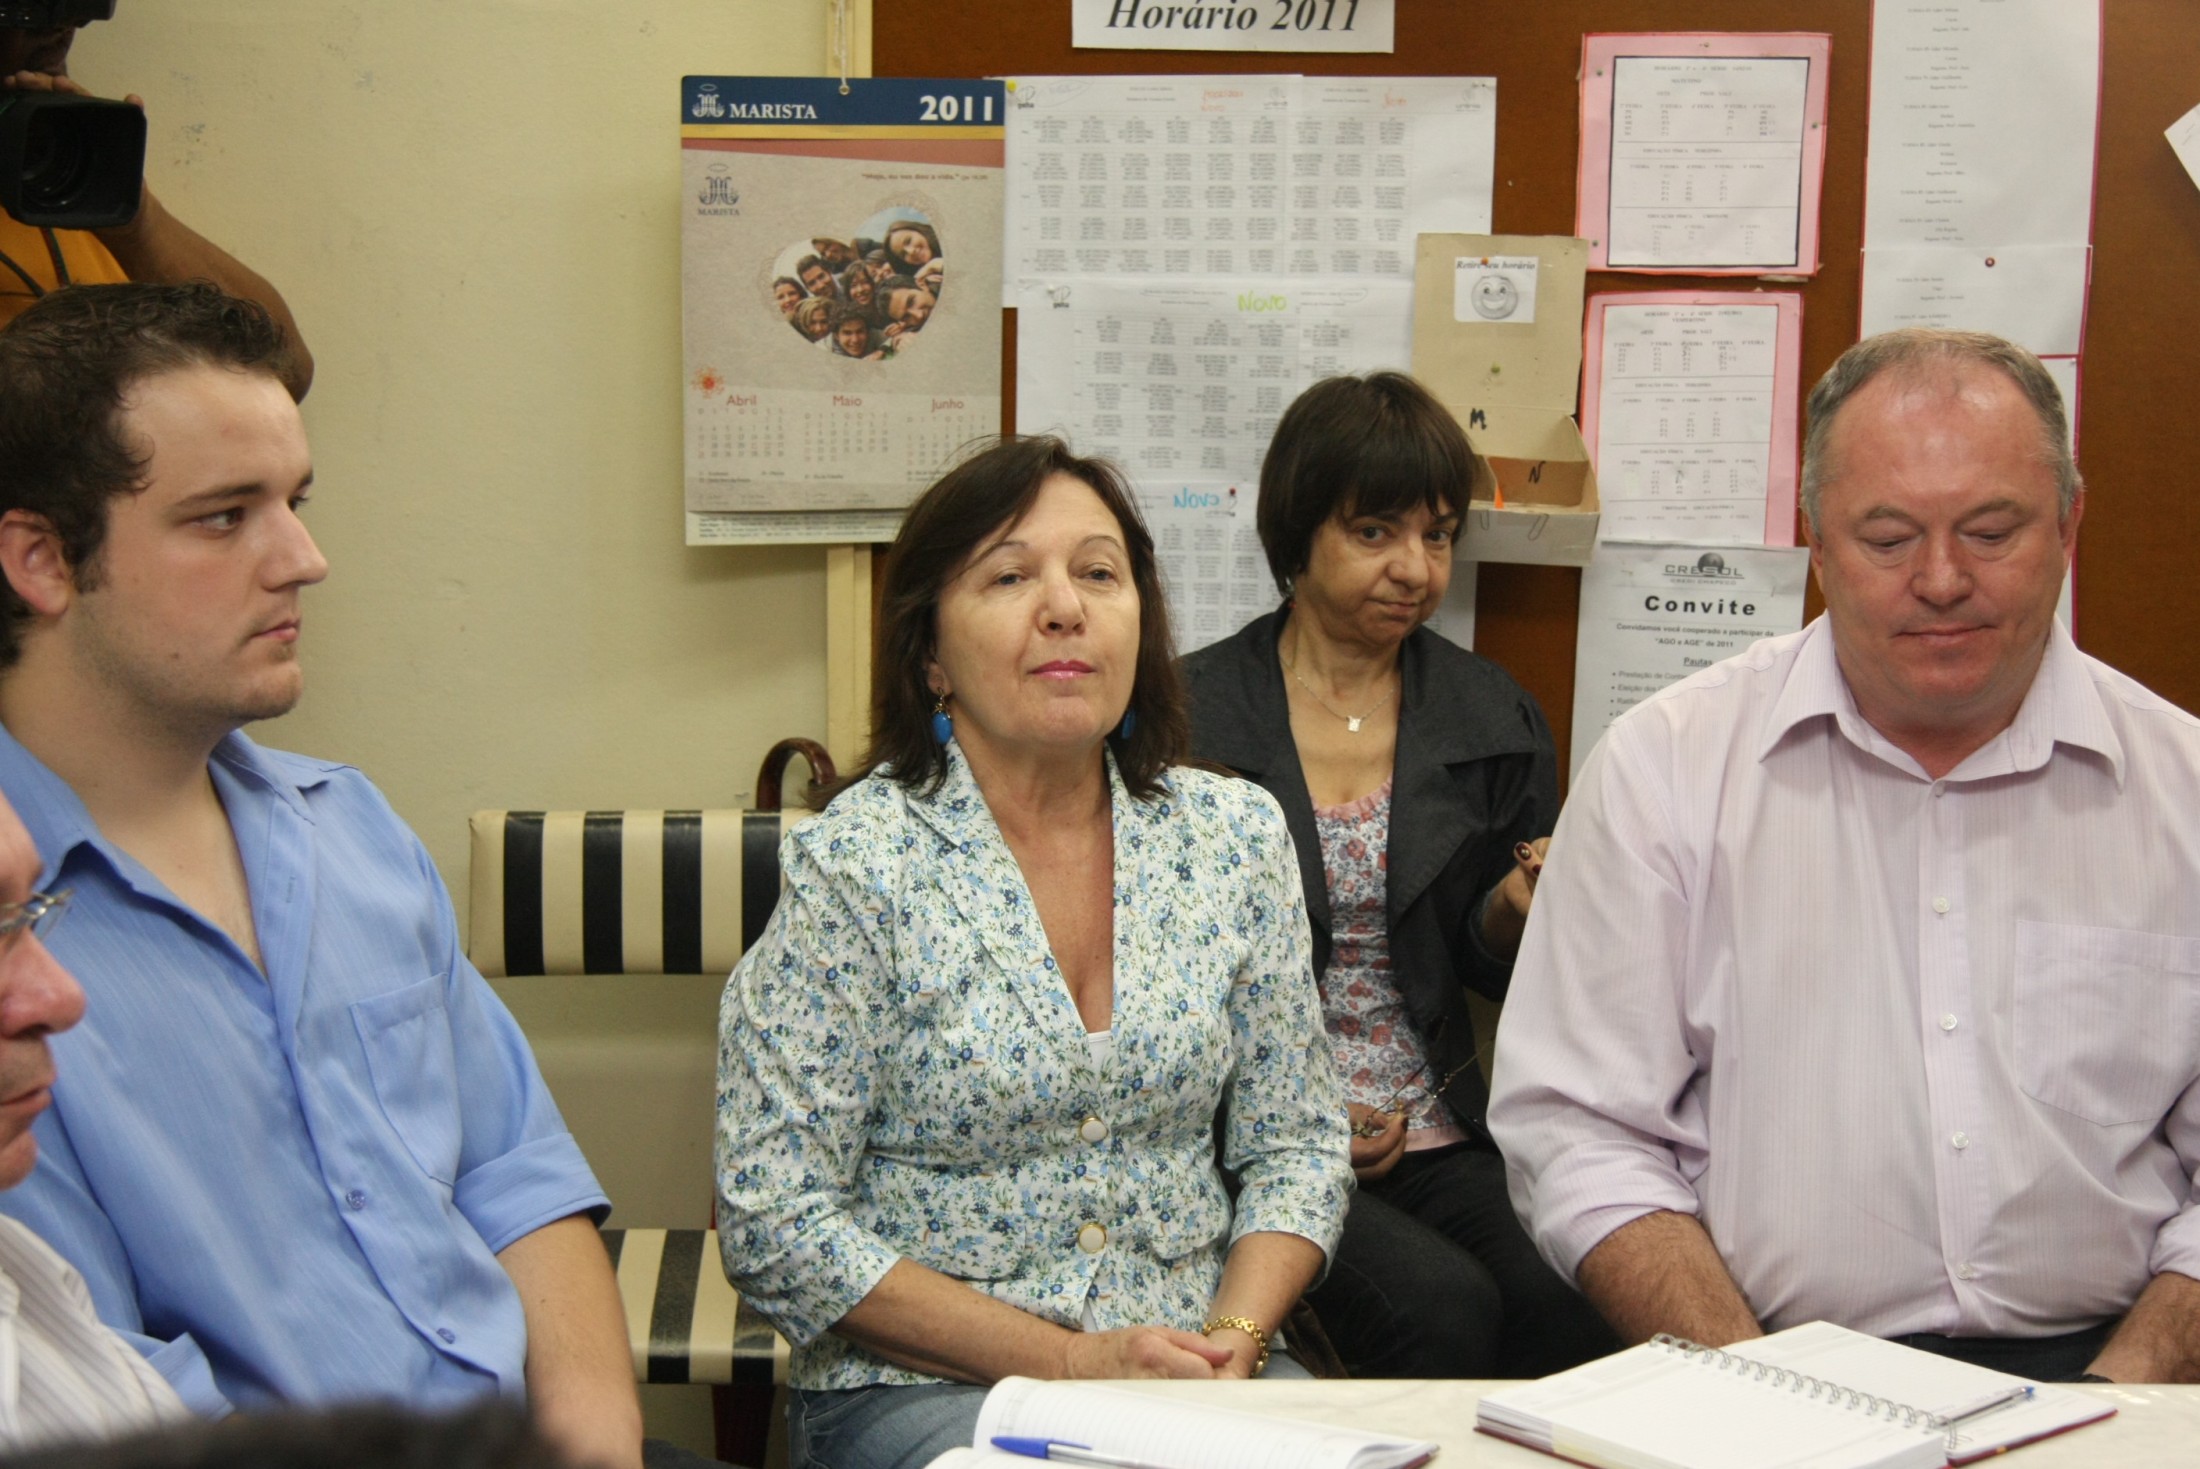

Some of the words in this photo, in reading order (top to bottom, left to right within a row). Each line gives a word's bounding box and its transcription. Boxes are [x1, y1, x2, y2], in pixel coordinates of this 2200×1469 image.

[1105, 0, 1258, 30] Horário
[1270, 0, 1361, 31] 2011
[729, 103, 818, 119] MARISTA
[919, 95, 993, 122] 2011
[726, 395, 757, 406] Abril
[833, 395, 862, 407] Maio
[931, 398, 964, 412] Junho
[1664, 564, 1743, 576] CRESOL
[1644, 595, 1756, 616] Convite
[1616, 622, 1661, 632] Convidamos
[1682, 626, 1721, 636] cooperado
[1729, 629, 1763, 637] participar
